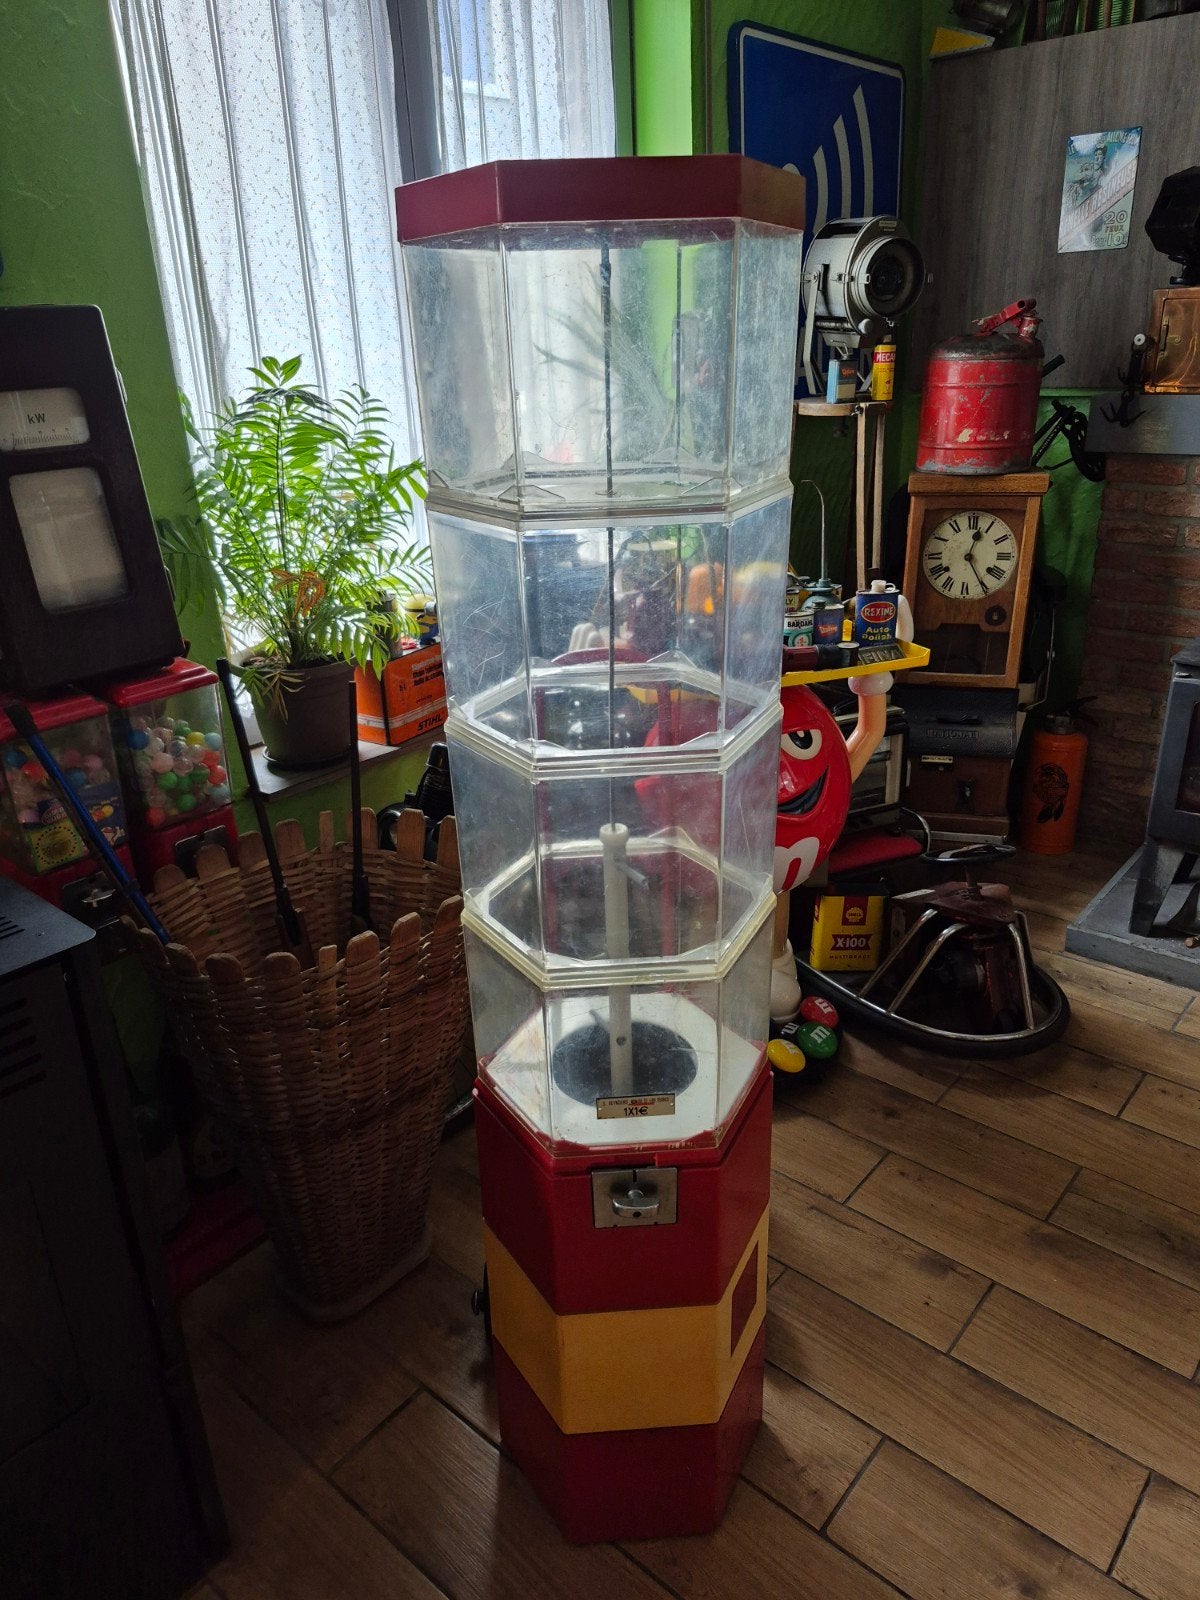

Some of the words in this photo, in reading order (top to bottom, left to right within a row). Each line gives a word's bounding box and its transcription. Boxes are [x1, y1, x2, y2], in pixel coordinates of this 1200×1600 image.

[1104, 210, 1128, 225] 20
[1104, 225, 1125, 233] FEUX
[27, 412, 46, 424] kW
[864, 606, 895, 618] REXINE
[866, 626, 890, 634] Auto
[862, 633, 892, 641] Polish
[417, 714, 442, 731] STIHL
[836, 937, 867, 948] X-100
